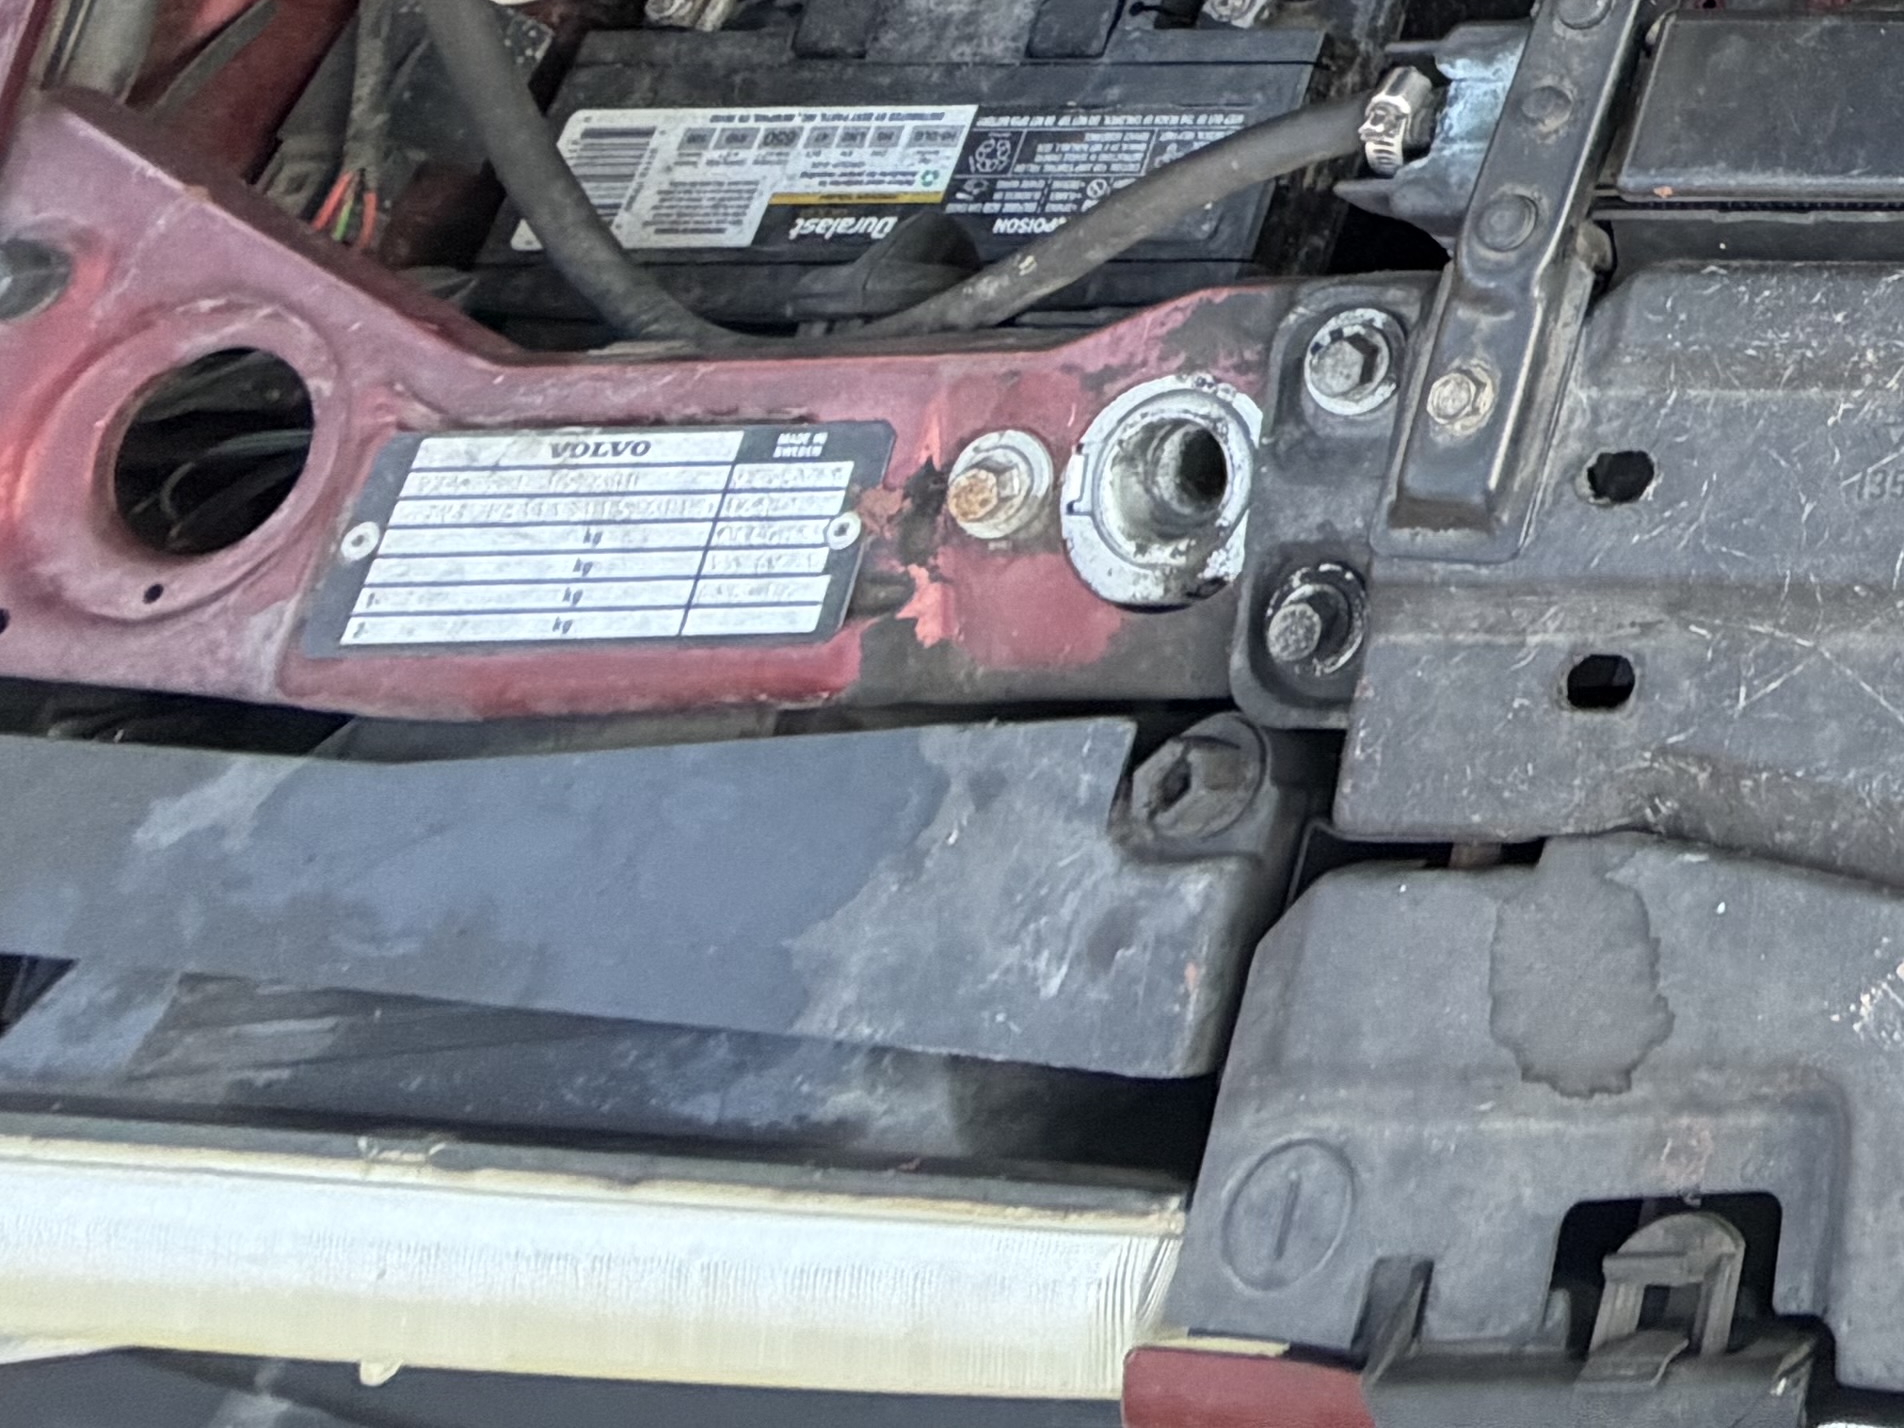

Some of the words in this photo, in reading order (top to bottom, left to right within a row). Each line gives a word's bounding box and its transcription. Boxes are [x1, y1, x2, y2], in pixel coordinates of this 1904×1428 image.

[788, 216, 898, 239] Duralast
[549, 440, 651, 459] VOLVO
[773, 446, 824, 458] SWEDEN
[583, 529, 603, 547] kg
[573, 558, 593, 576] kg
[562, 587, 583, 606] kg
[552, 617, 573, 635] kg
